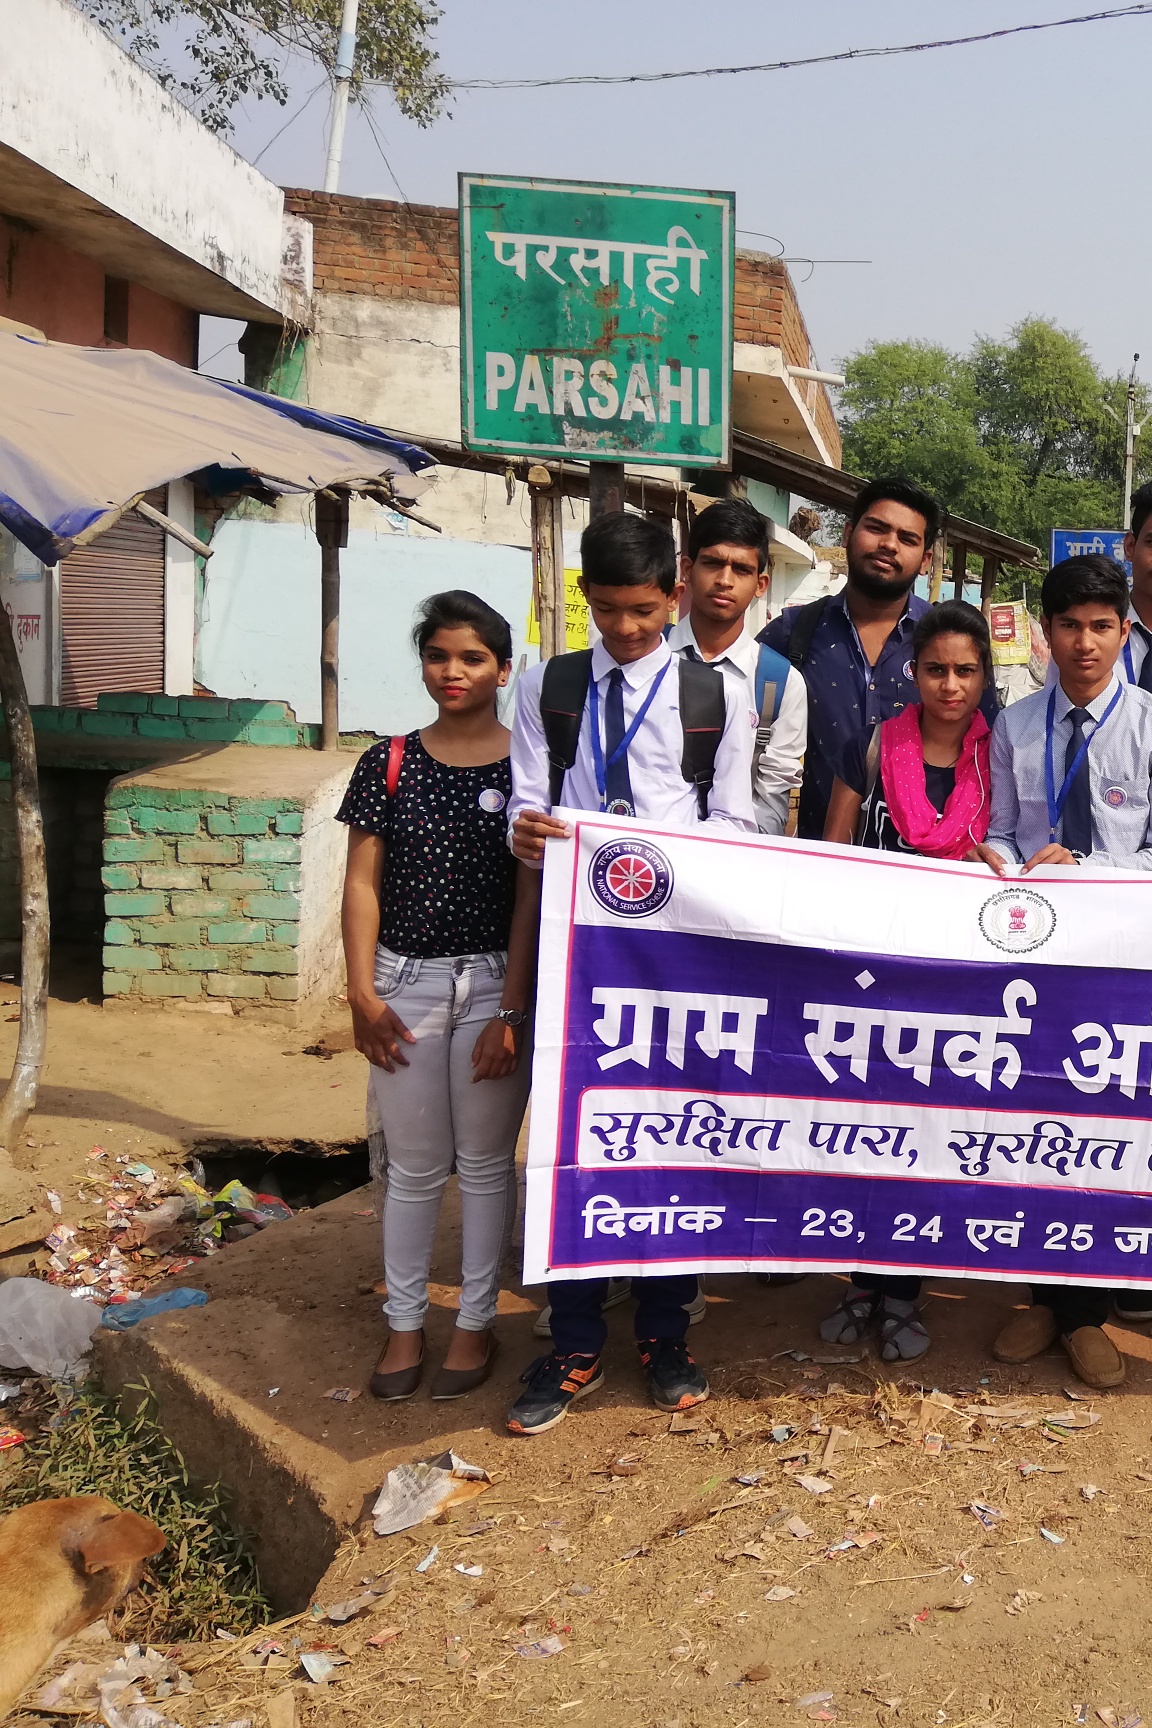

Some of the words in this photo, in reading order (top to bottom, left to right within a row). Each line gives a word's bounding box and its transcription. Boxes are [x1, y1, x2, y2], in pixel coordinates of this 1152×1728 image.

[485, 225, 709, 305] परसाही
[485, 351, 711, 426] PARSAHI
[17, 614, 41, 653] दुकान
[622, 841, 643, 854] सेवा
[644, 849, 665, 873] योजना
[596, 878, 619, 907] NATIONAL
[619, 902, 647, 911] SERVICE
[646, 887, 665, 907] SCHEME
[592, 986, 768, 1076] ग्राम
[803, 969, 1037, 1092] संपर्क
[589, 1099, 791, 1162] सुरक्षित
[808, 1120, 918, 1168] पारा,
[947, 1120, 1134, 1177] सुरक्षित
[581, 1194, 726, 1239] दिनांक
[800, 1207, 866, 1244] 23,
[891, 1214, 943, 1243] 24
[965, 1211, 1025, 1254] एवं
[1044, 1221, 1095, 1252] 25
